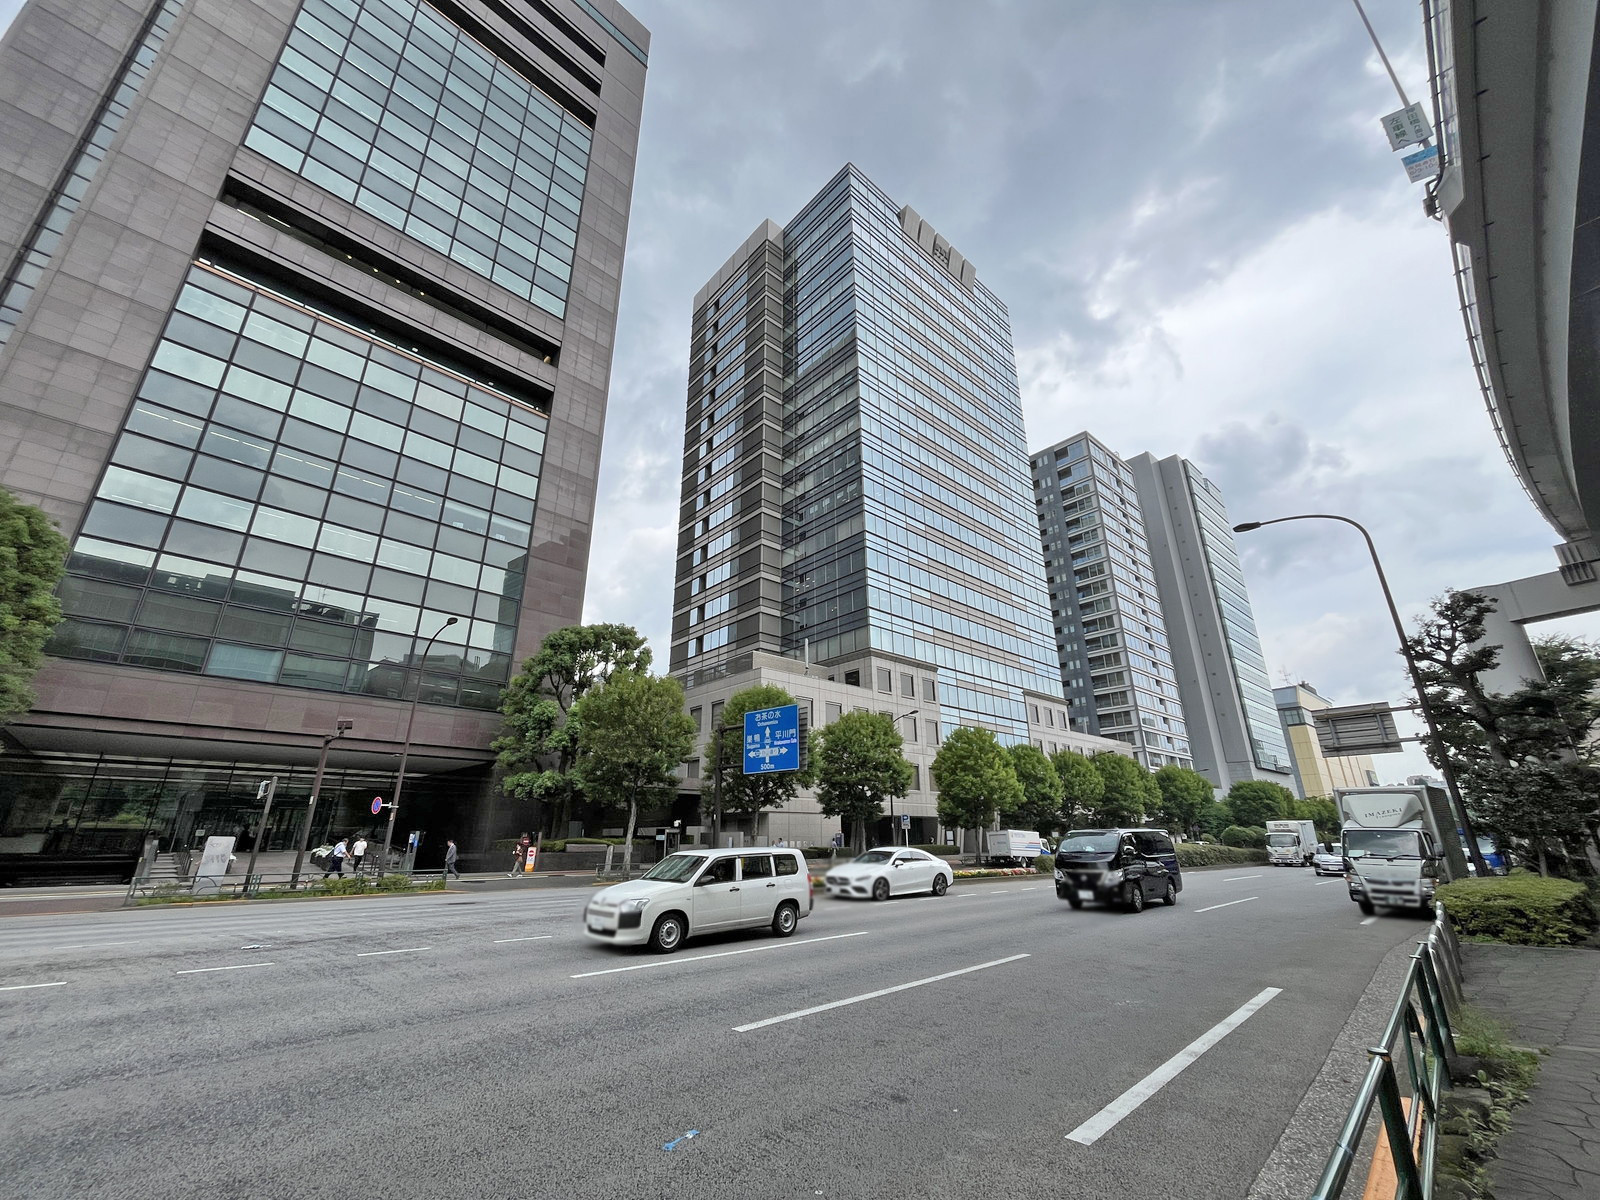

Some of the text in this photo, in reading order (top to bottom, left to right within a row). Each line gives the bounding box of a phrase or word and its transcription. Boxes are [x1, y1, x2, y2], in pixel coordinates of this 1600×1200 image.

[1388, 116, 1411, 145] 左車線へ
[755, 710, 781, 721] お茶の水
[775, 728, 796, 739] 平川門
[1364, 807, 1403, 818] IMAZEKI
